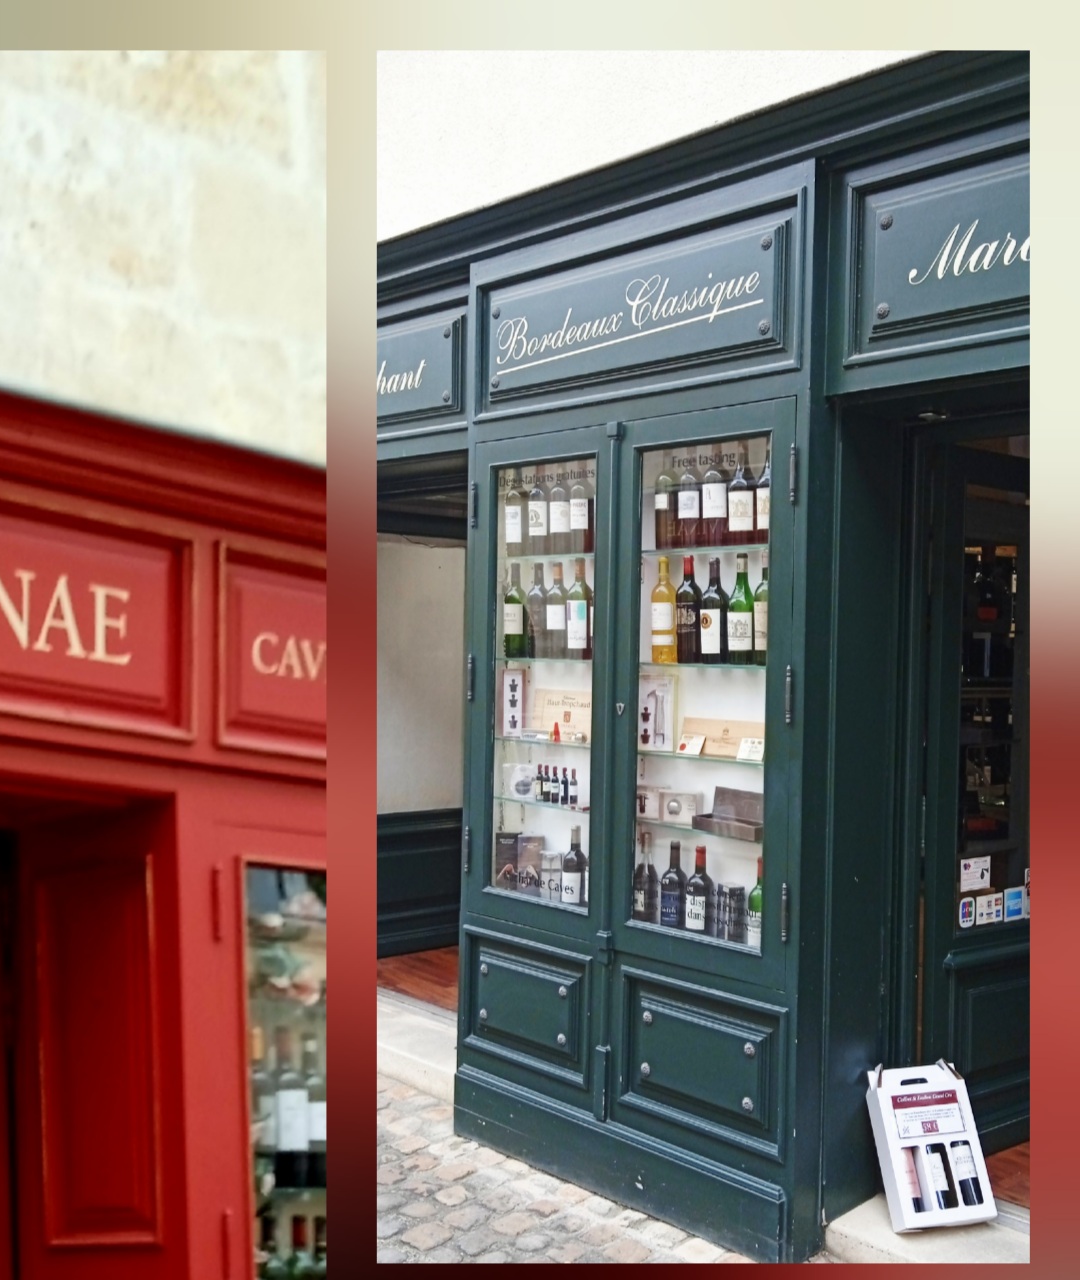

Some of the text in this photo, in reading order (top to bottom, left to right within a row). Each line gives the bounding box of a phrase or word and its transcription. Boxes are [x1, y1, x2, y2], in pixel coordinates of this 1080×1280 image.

[496, 268, 762, 365] Bordeaux Classique
[671, 452, 736, 470] Free tasting
[499, 468, 596, 489] Dégustations gratuites
[548, 878, 575, 895] Caves
